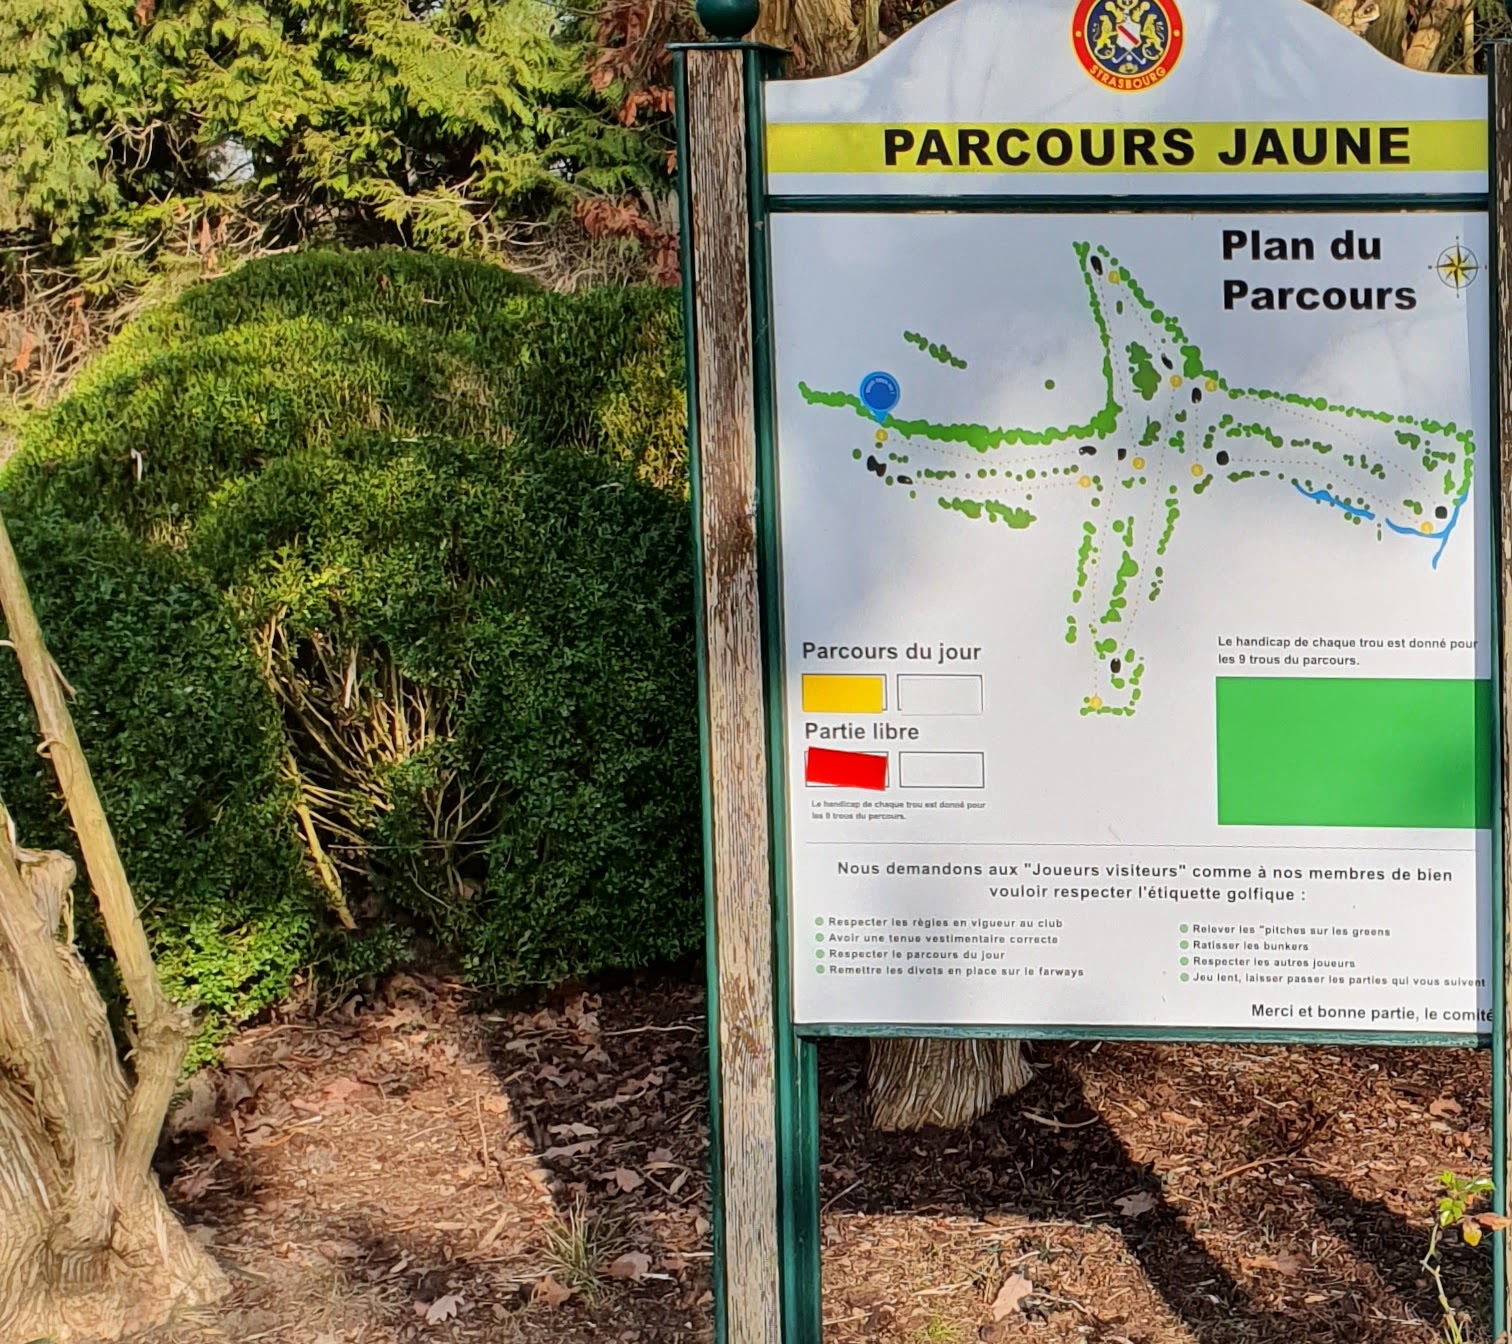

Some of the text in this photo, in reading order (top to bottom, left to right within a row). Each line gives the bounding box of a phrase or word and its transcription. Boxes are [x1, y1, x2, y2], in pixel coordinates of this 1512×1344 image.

[1090, 65, 1166, 89] STRASBOURG
[885, 127, 1410, 166] PARCOURS JAUNE
[1223, 230, 1381, 261] Plan du
[1223, 280, 1416, 310] Parcours
[1218, 636, 1477, 652] Le handicap de chaque trou est donné pour
[802, 642, 982, 664] Parcours du jour
[1218, 654, 1360, 668] les 9 trous du parcours.
[806, 722, 920, 740] Partie libre
[838, 862, 1452, 882] Nous demandons aux "Joueurs visiteurs" comme à nos membres de bien
[990, 884, 1048, 898] vouloir
[1054, 886, 1132, 902] respecter
[1138, 886, 1220, 902] l'étiquette
[1226, 888, 1294, 904] golfique
[828, 916, 888, 928] Respecter
[892, 918, 908, 926] les
[912, 918, 948, 928] règles
[972, 918, 1016, 930] vigueur
[1020, 920, 1034, 928] au
[1038, 918, 1062, 928] club
[1192, 924, 1236, 934] Relever
[1240, 924, 1256, 934] les
[1310, 928, 1328, 936] sur
[1332, 926, 1348, 936] les
[1352, 928, 1390, 938] greens
[828, 932, 860, 942] Avoir
[888, 934, 920, 942] tenue
[926, 934, 1006, 944] vestimentaire
[1010, 936, 1058, 944] correcte
[1194, 940, 1308, 950] Ratisser les bunkers
[830, 948, 1006, 962] Respecter le parcours du jour
[1194, 956, 1356, 970] Respecter les autres joueurs
[830, 964, 882, 974] Remettre
[886, 966, 904, 974] les
[908, 966, 944, 974] divots
[966, 966, 996, 978] place
[1002, 968, 1020, 976] sur
[1024, 966, 1034, 976] le
[1038, 966, 1084, 978] farways
[1192, 972, 1485, 987] Jeu lent, laisser passer les parties qui vous suivent
[1252, 1004, 1292, 1016] Merci
[1298, 1006, 1312, 1018] et
[1318, 1004, 1366, 1018] bonne
[1372, 1006, 1418, 1022] partie,
[1424, 1008, 1438, 1020] le
